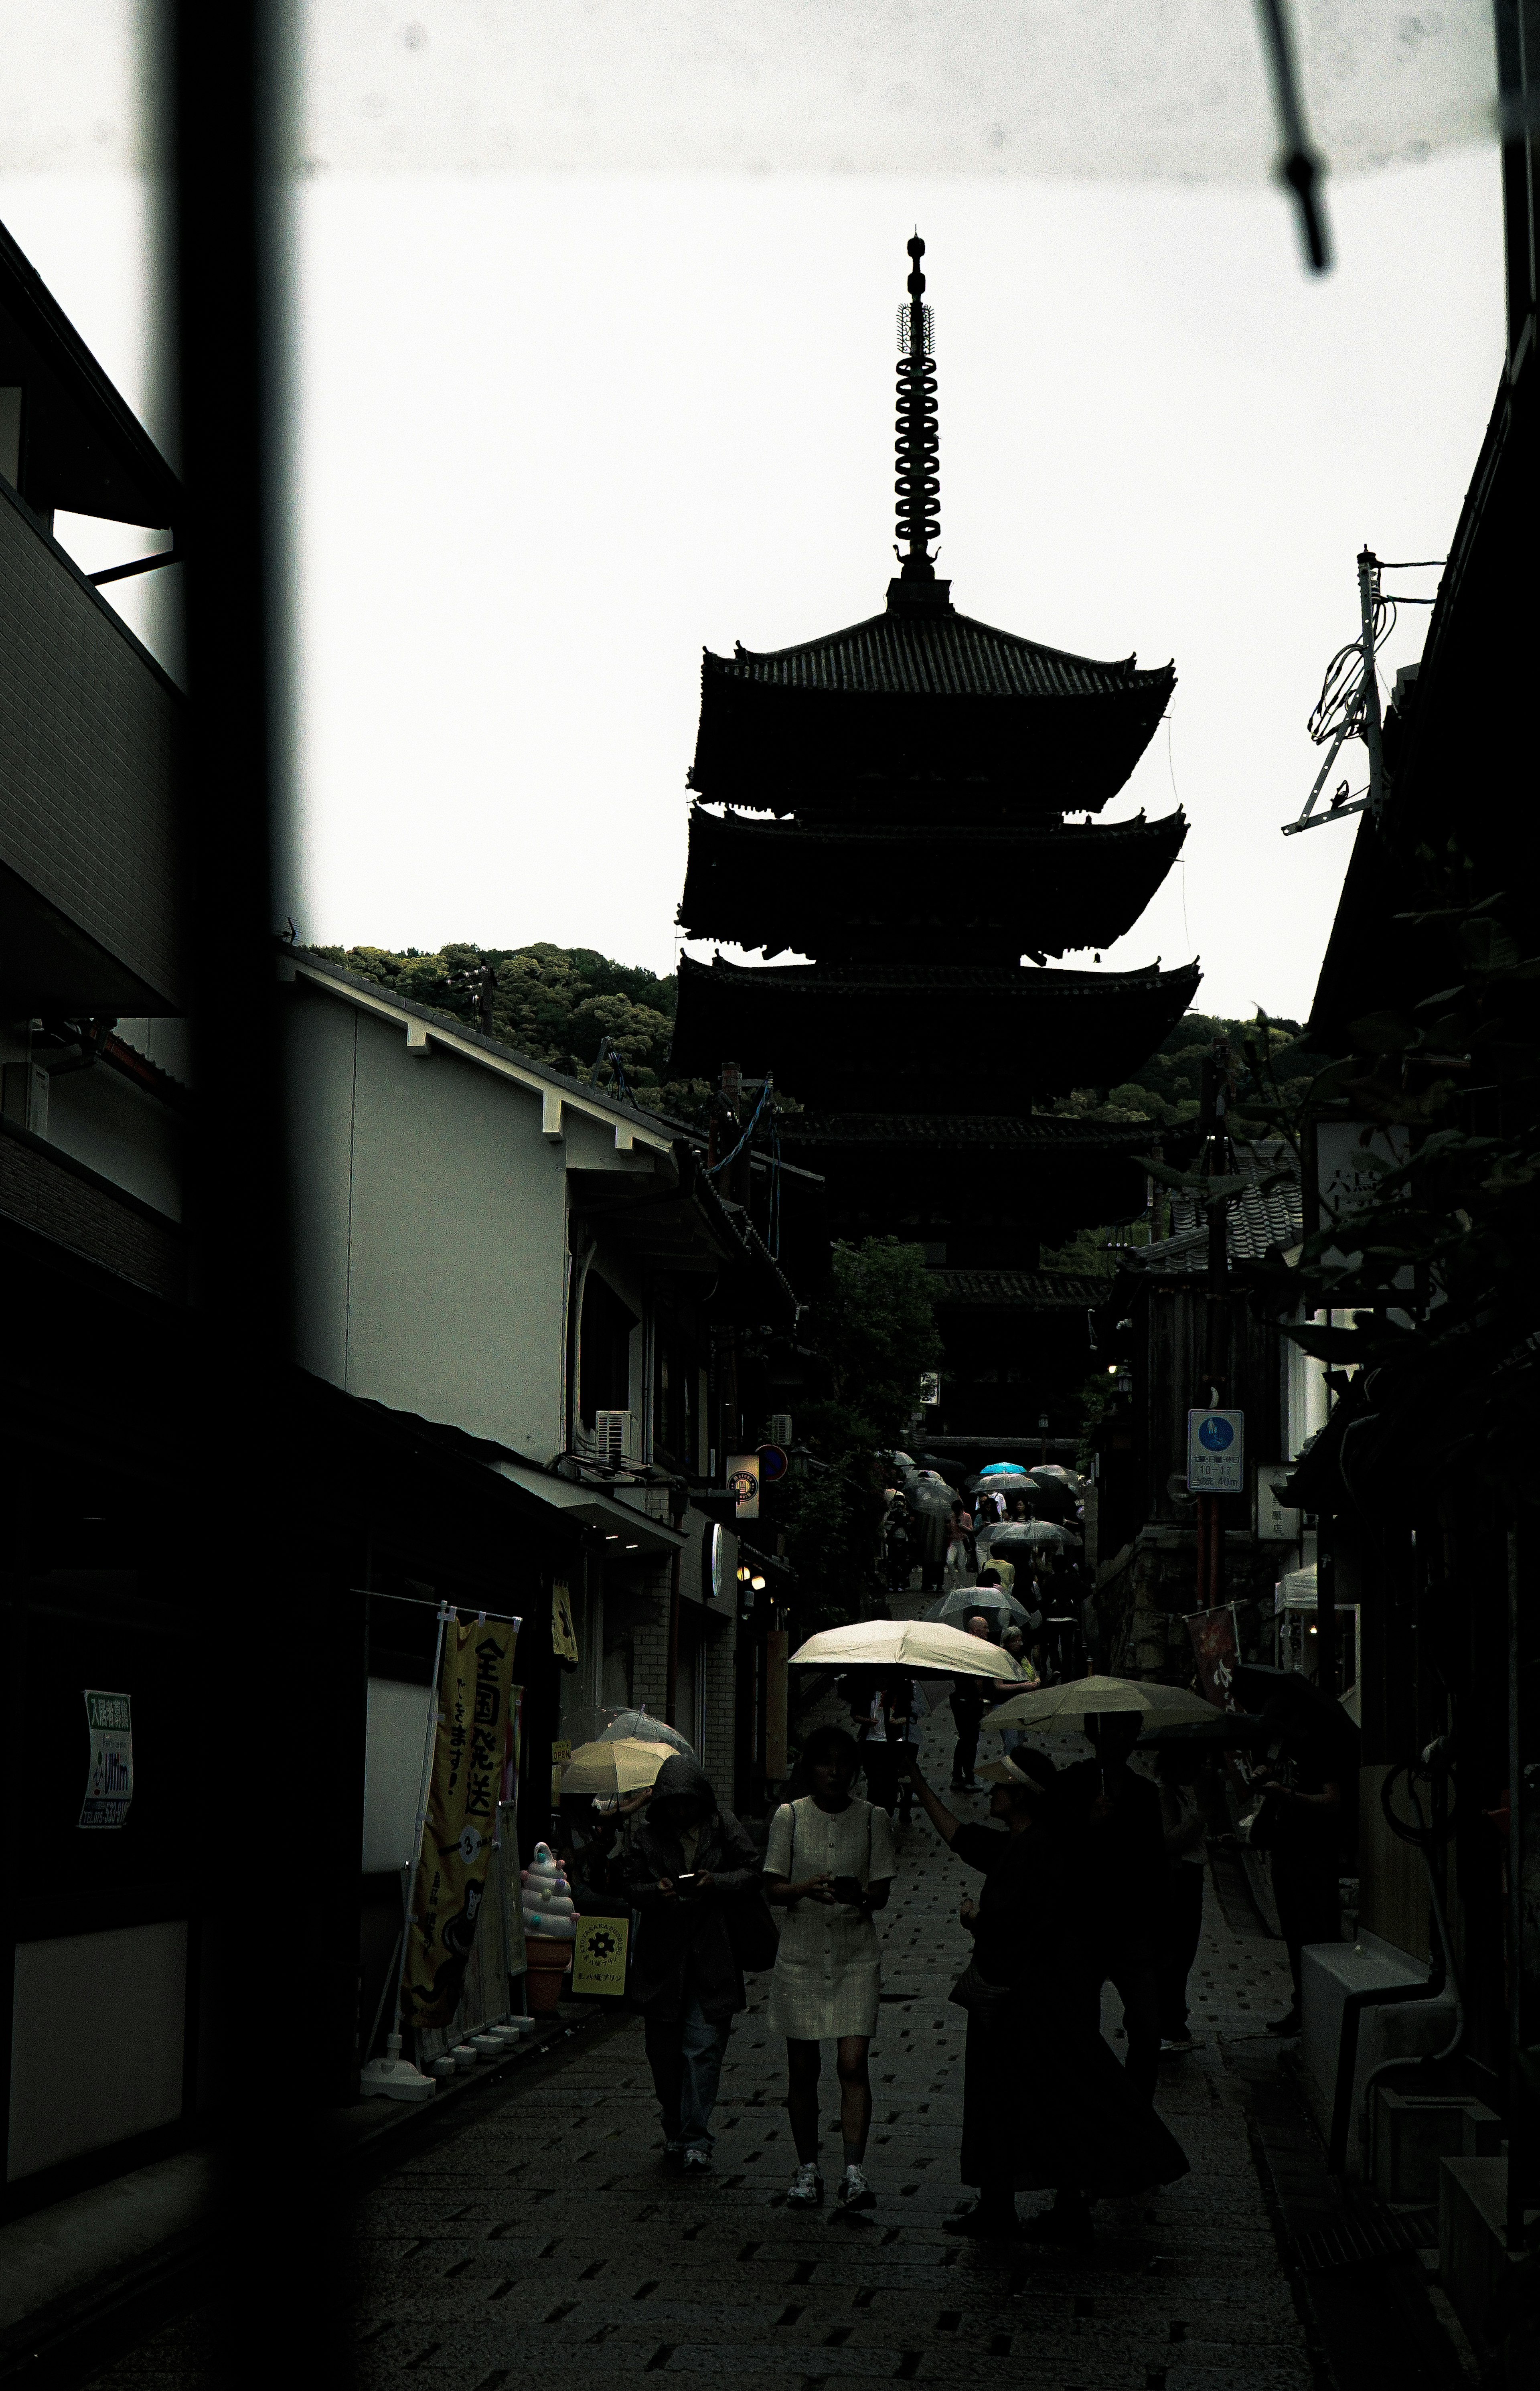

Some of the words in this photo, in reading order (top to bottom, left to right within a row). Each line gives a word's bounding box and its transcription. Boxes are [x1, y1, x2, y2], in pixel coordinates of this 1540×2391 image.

[1218, 1477, 1238, 1487] 40m
[1271, 1469, 1283, 1535] 大服店
[91, 1698, 128, 1728] 入居者募集
[466, 1638, 505, 1817] 全国発送
[448, 1678, 466, 1795] できます！
[553, 1750, 571, 1760] OPEN
[464, 1836, 473, 1855] 3
